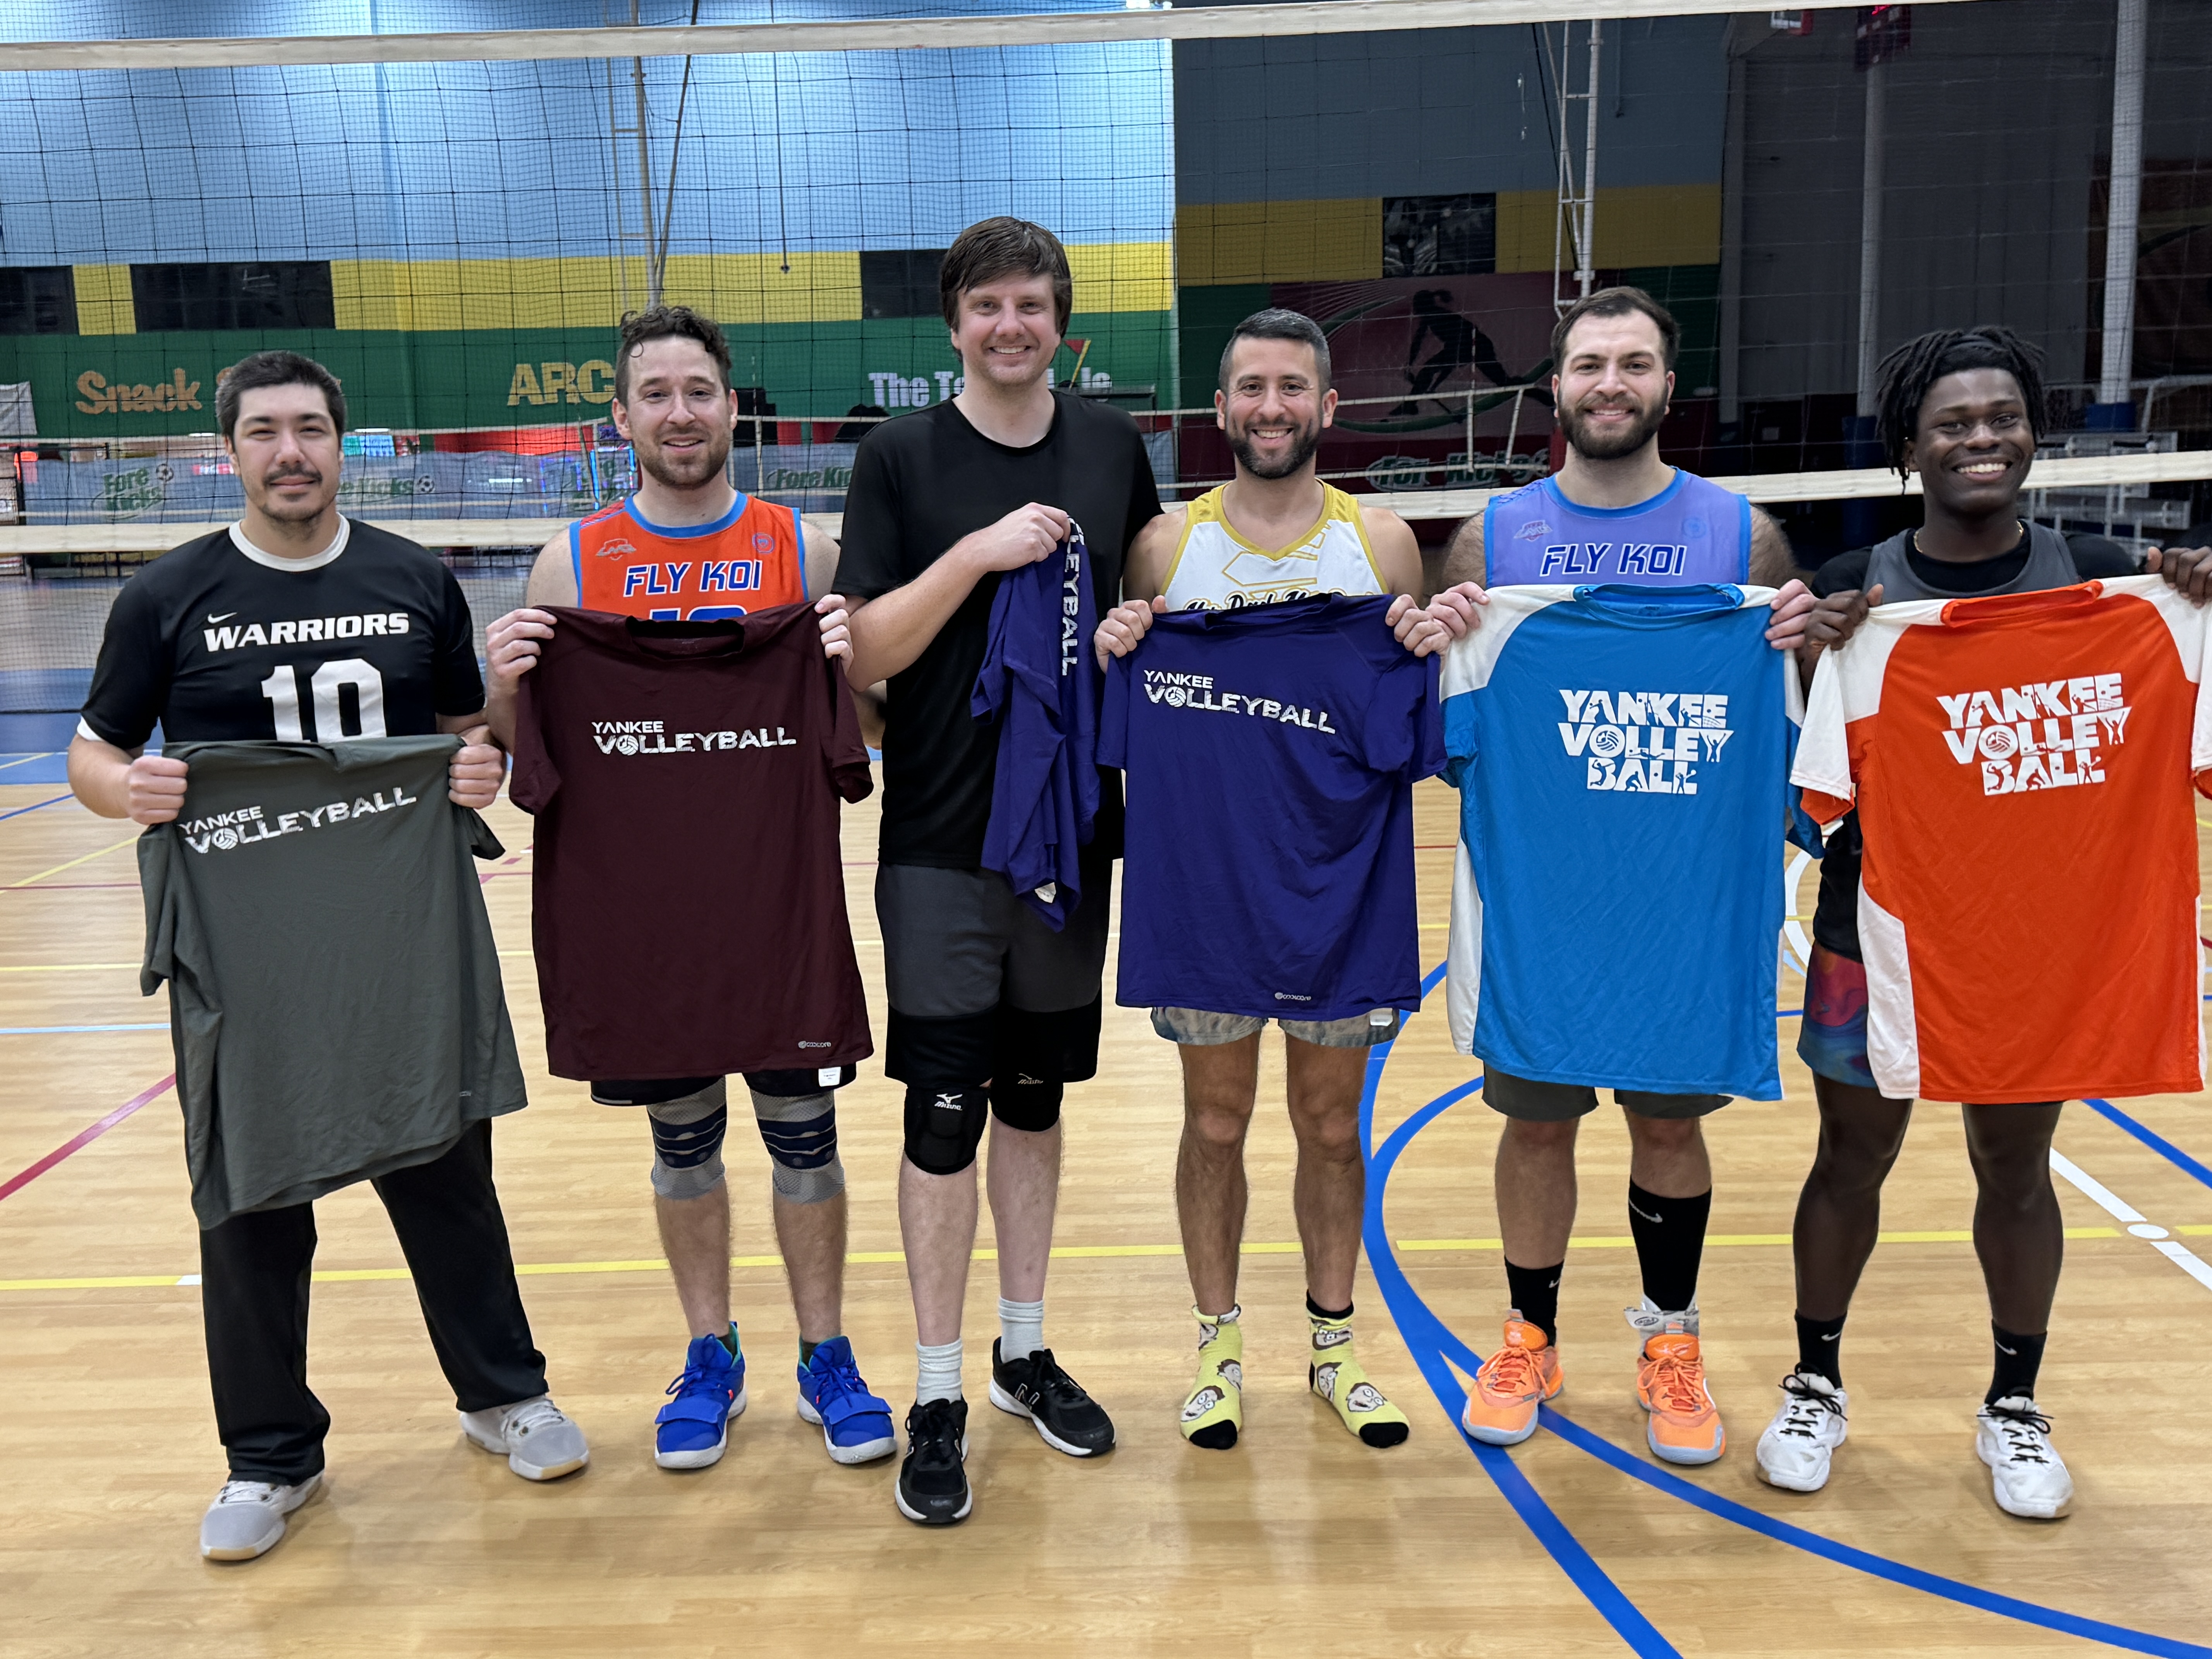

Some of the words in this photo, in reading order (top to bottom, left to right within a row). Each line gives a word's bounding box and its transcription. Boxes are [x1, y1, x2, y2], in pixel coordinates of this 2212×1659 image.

[76, 368, 202, 415] Snack
[507, 359, 616, 407] ARC
[868, 372, 929, 407] The
[775, 468, 823, 490] Fore
[623, 562, 693, 597] FLY
[699, 560, 762, 591] KOI
[1540, 543, 1613, 577] FLY
[1617, 543, 1687, 576] KOI
[203, 613, 409, 652] WARRIORS
[1144, 670, 1214, 689] YANKEE
[261, 658, 387, 743] 10
[1144, 683, 1336, 734] VOLLEYBALL
[1559, 689, 1728, 728] YANKEE
[1936, 673, 2124, 729] YANKEE
[591, 721, 664, 734] YANKEE
[593, 726, 797, 755] VOLLEYBALL
[1558, 722, 1735, 763] VOLLEY
[1941, 706, 2133, 764] VOLLEY
[1587, 757, 1697, 795] BALL
[1981, 749, 2106, 796] BALL
[178, 805, 263, 835] YANKEE
[185, 787, 417, 854] VOLLEYBALL
